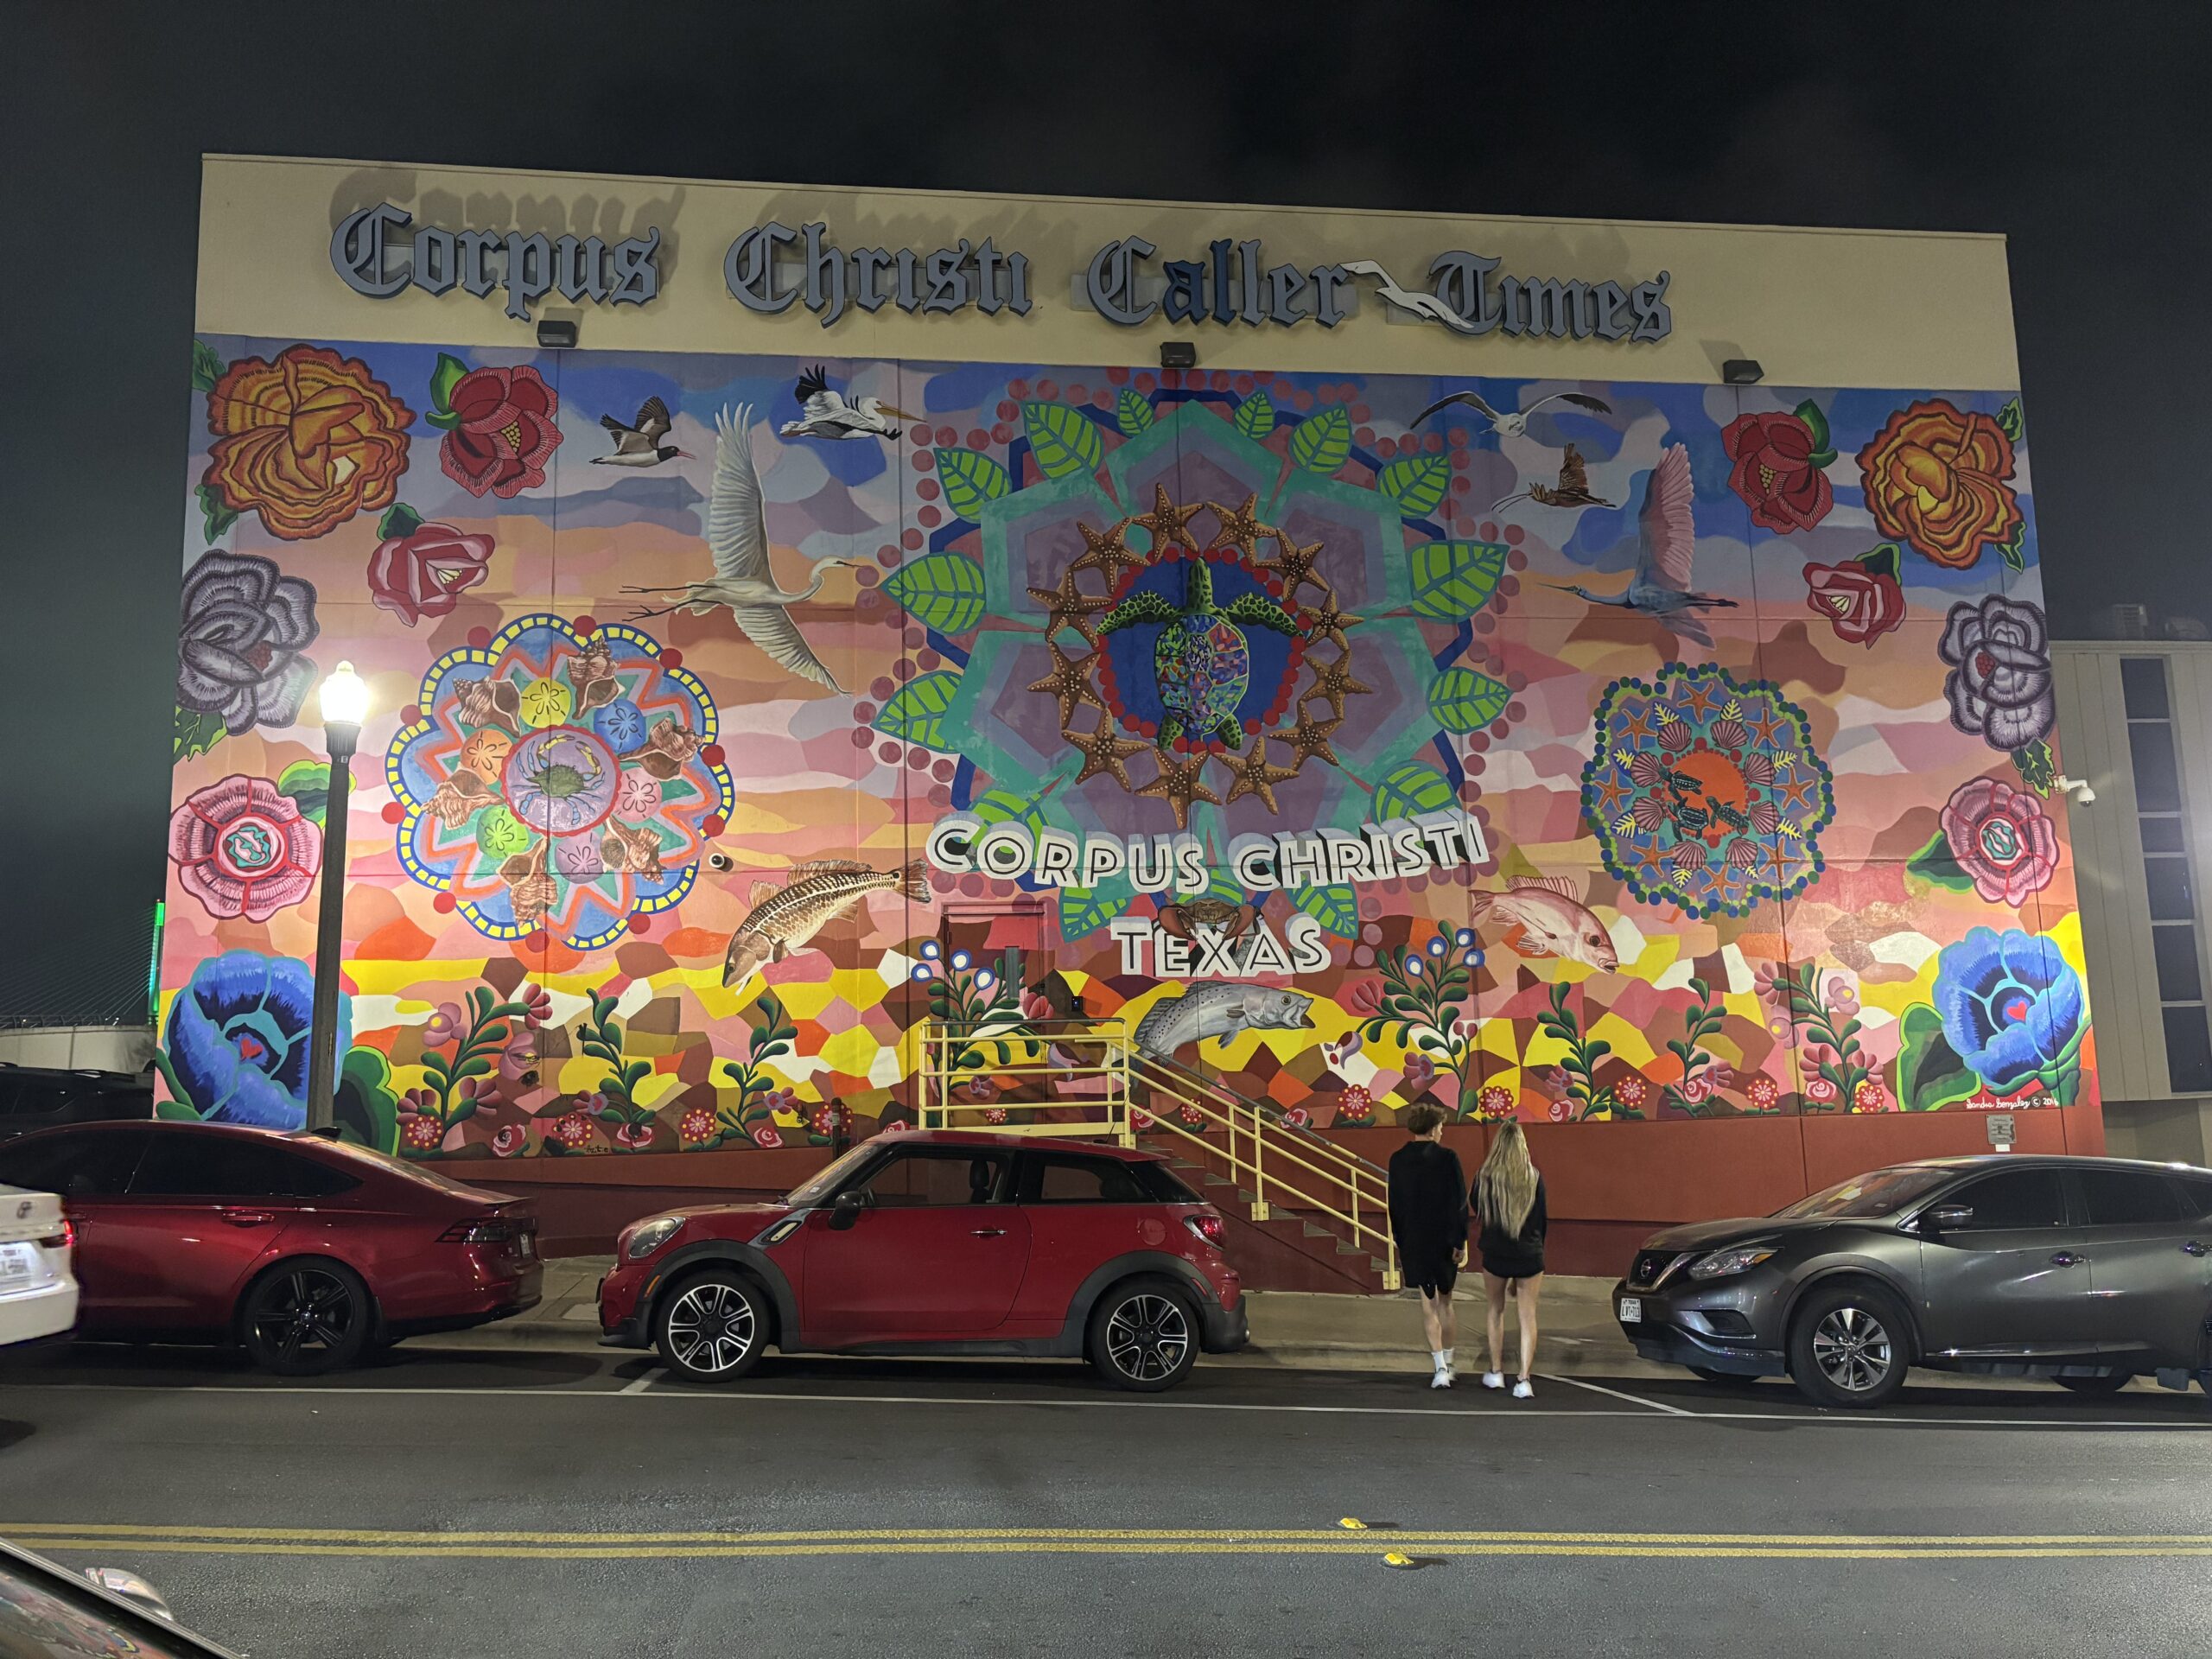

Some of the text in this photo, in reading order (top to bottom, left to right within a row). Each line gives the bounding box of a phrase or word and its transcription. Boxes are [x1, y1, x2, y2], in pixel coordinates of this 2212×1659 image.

[330, 202, 1672, 343] Corpus Christi Caller Times
[925, 808, 1491, 895] CORPUS CHRISTI
[1110, 916, 1332, 978] TEXAS
